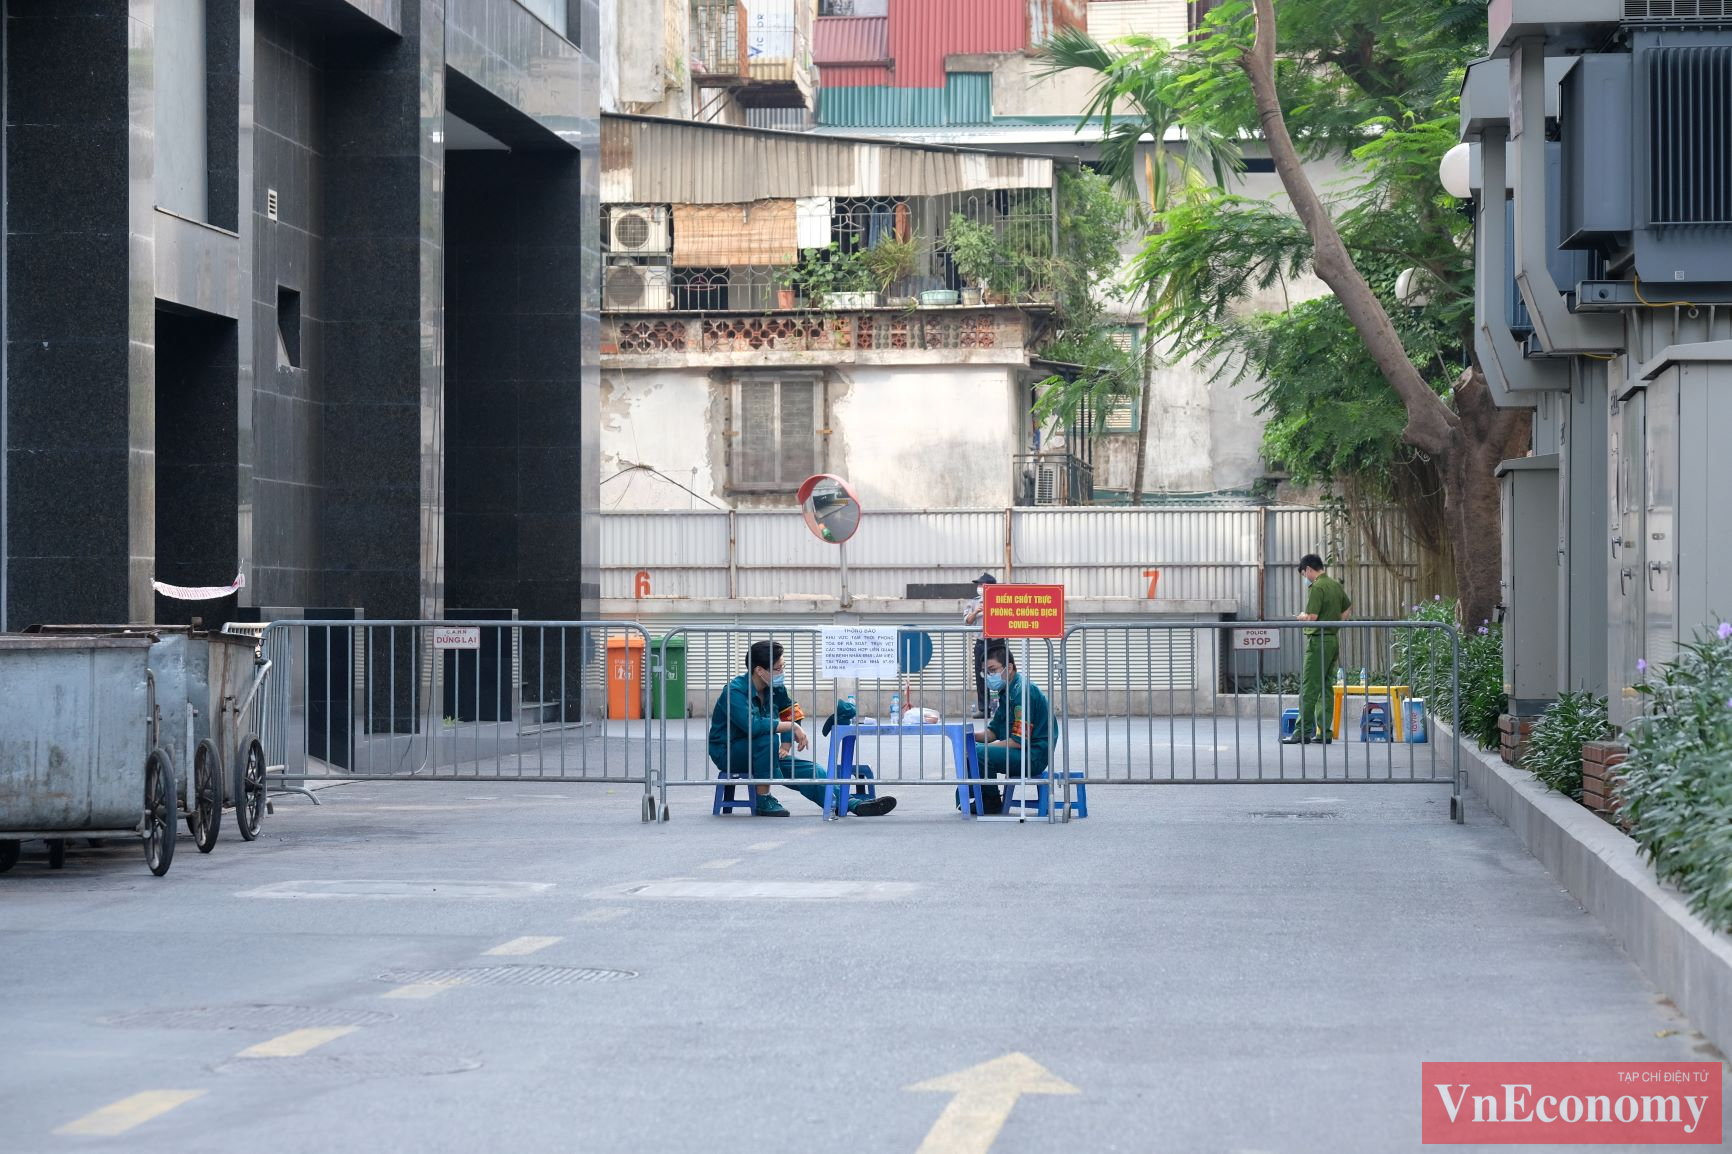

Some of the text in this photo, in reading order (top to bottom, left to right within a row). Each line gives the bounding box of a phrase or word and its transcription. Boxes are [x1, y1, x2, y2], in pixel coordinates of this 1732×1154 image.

[1143, 570, 1160, 599] 7
[1014, 593, 1033, 604] CHỐT
[1034, 594, 1052, 606] TRỰC
[1016, 605, 1039, 617] CHỐNG
[1008, 620, 1040, 629] COVID-19
[462, 637, 477, 645] LẠI
[1243, 638, 1271, 646] STOP
